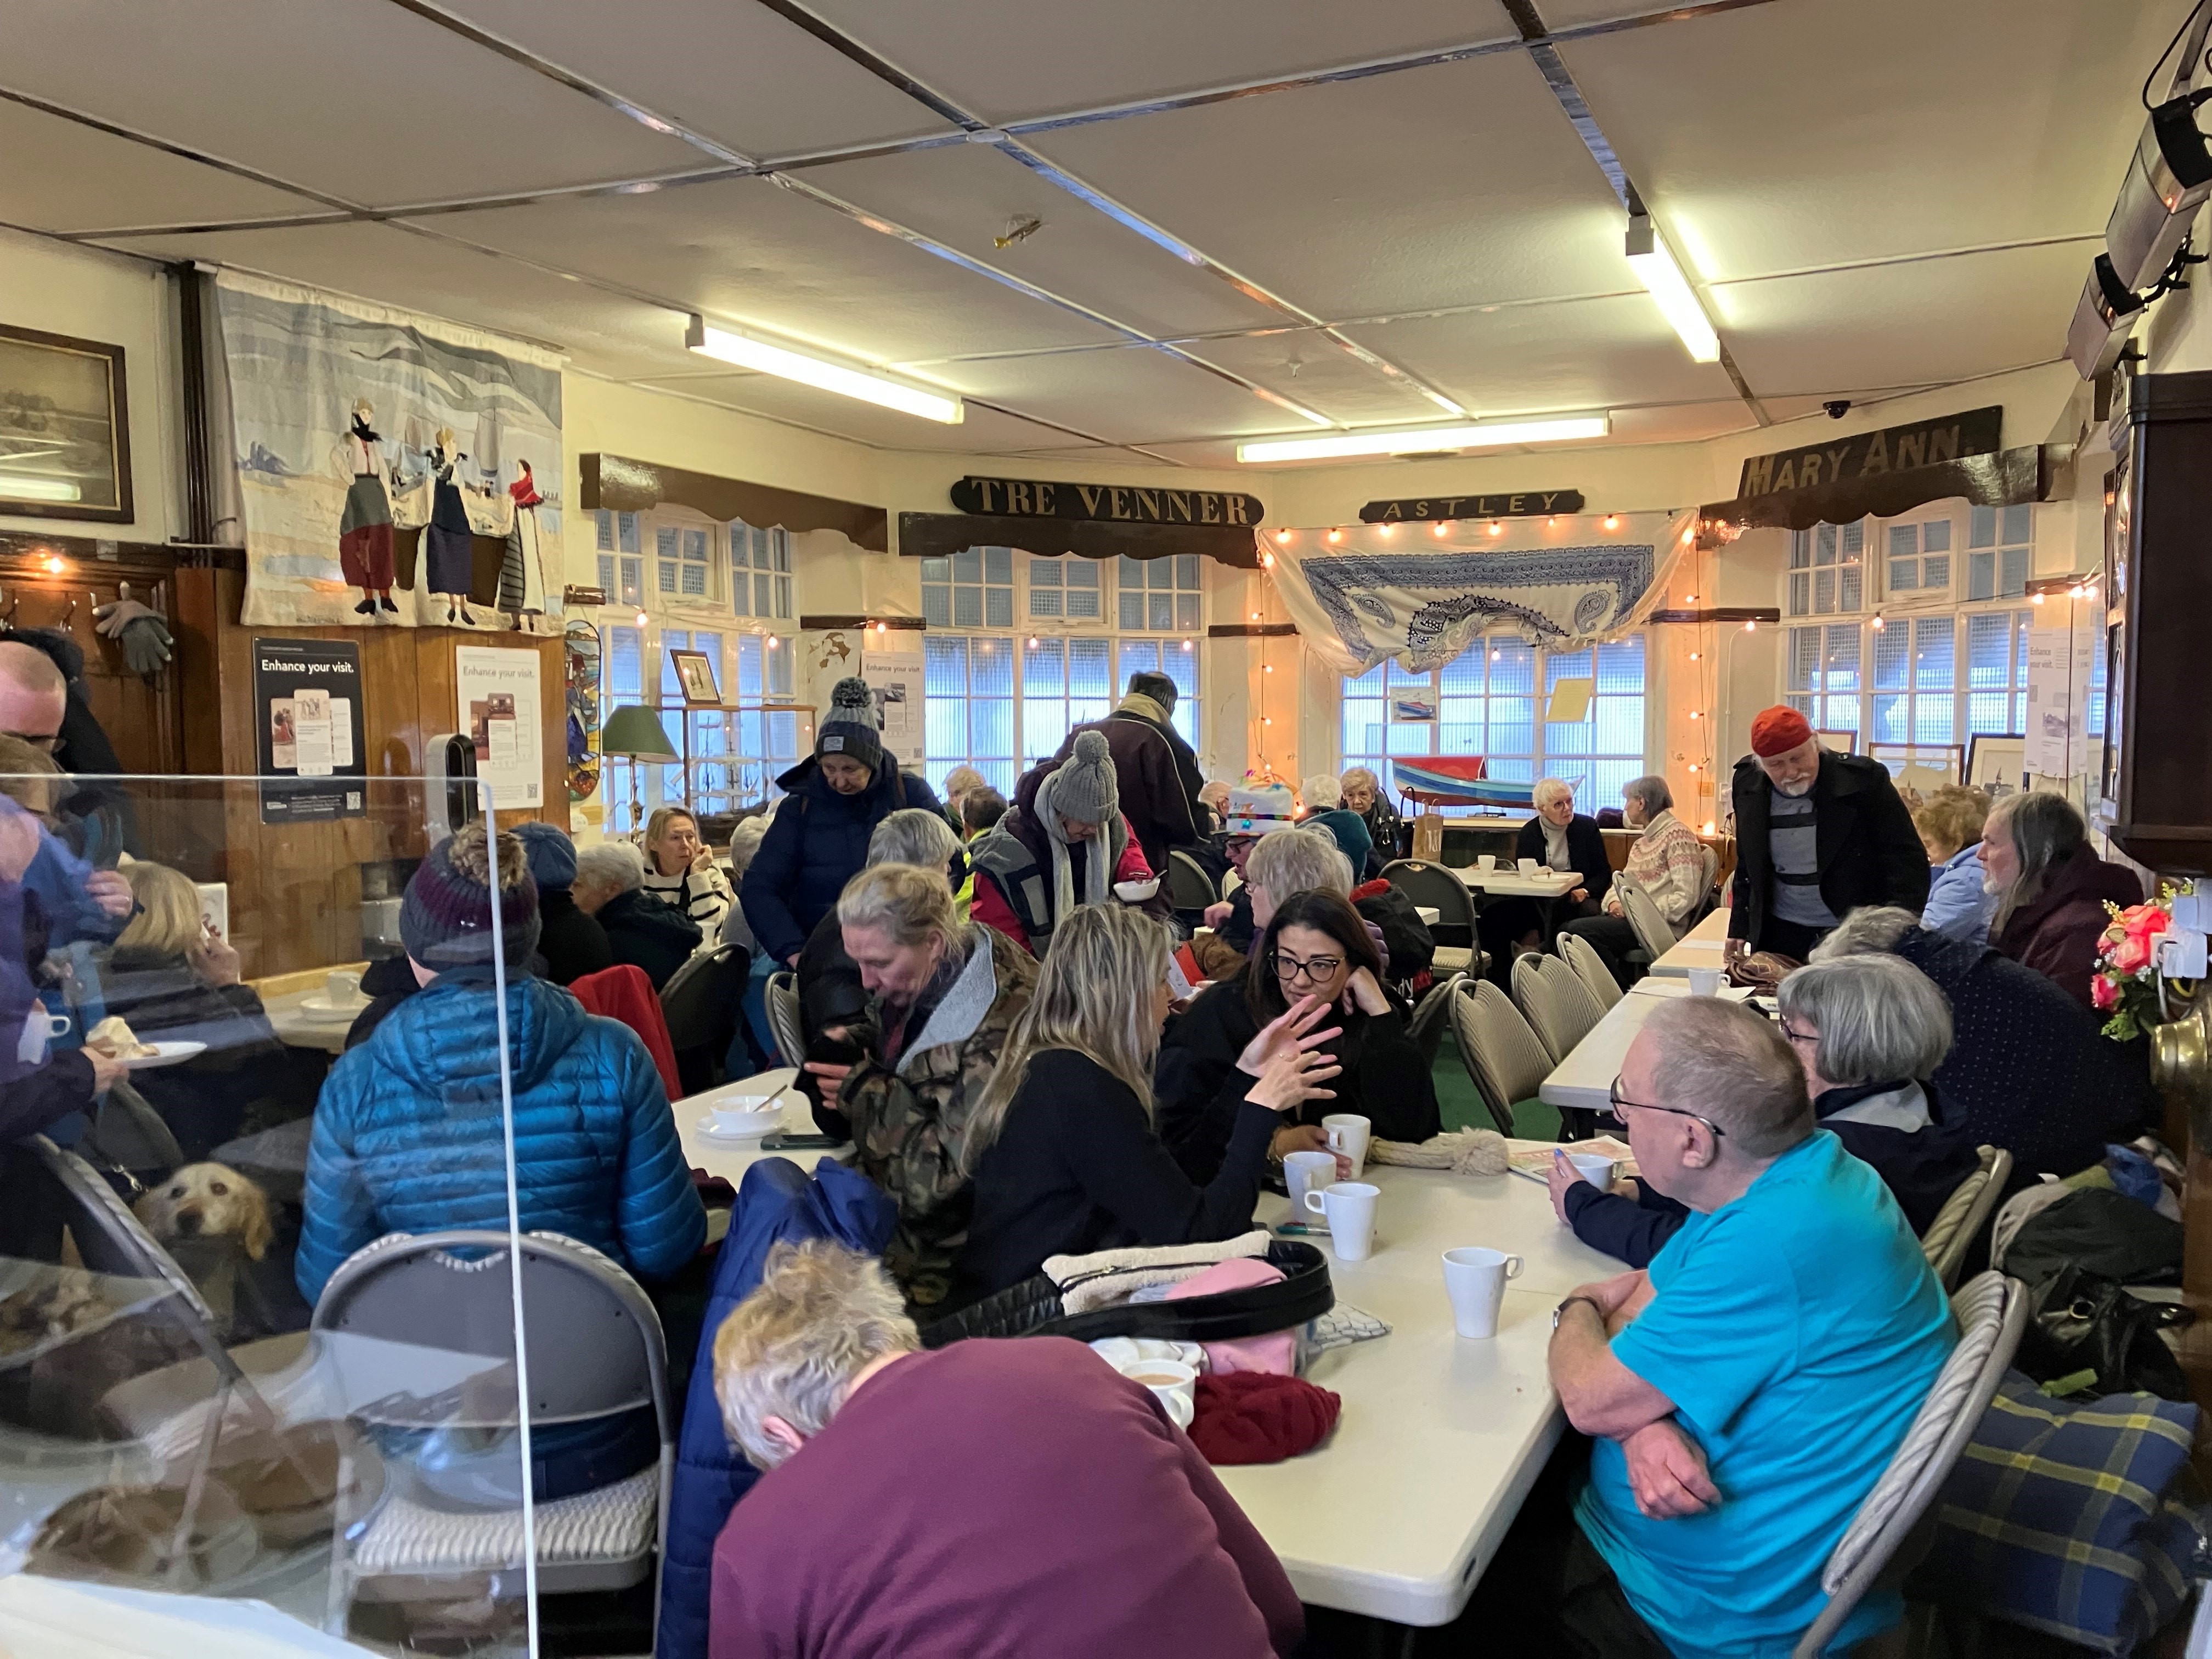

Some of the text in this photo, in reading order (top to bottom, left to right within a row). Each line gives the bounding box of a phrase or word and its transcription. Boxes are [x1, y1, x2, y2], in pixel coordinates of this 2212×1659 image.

[1744, 425, 1975, 496] MARY ANN.
[971, 478, 1248, 524] TRE VENNER
[1383, 493, 1558, 518] ASTLEY
[261, 659, 354, 675] Enhance your visit.
[463, 665, 534, 680] Enhance your visit.
[866, 663, 891, 672] Enhance
